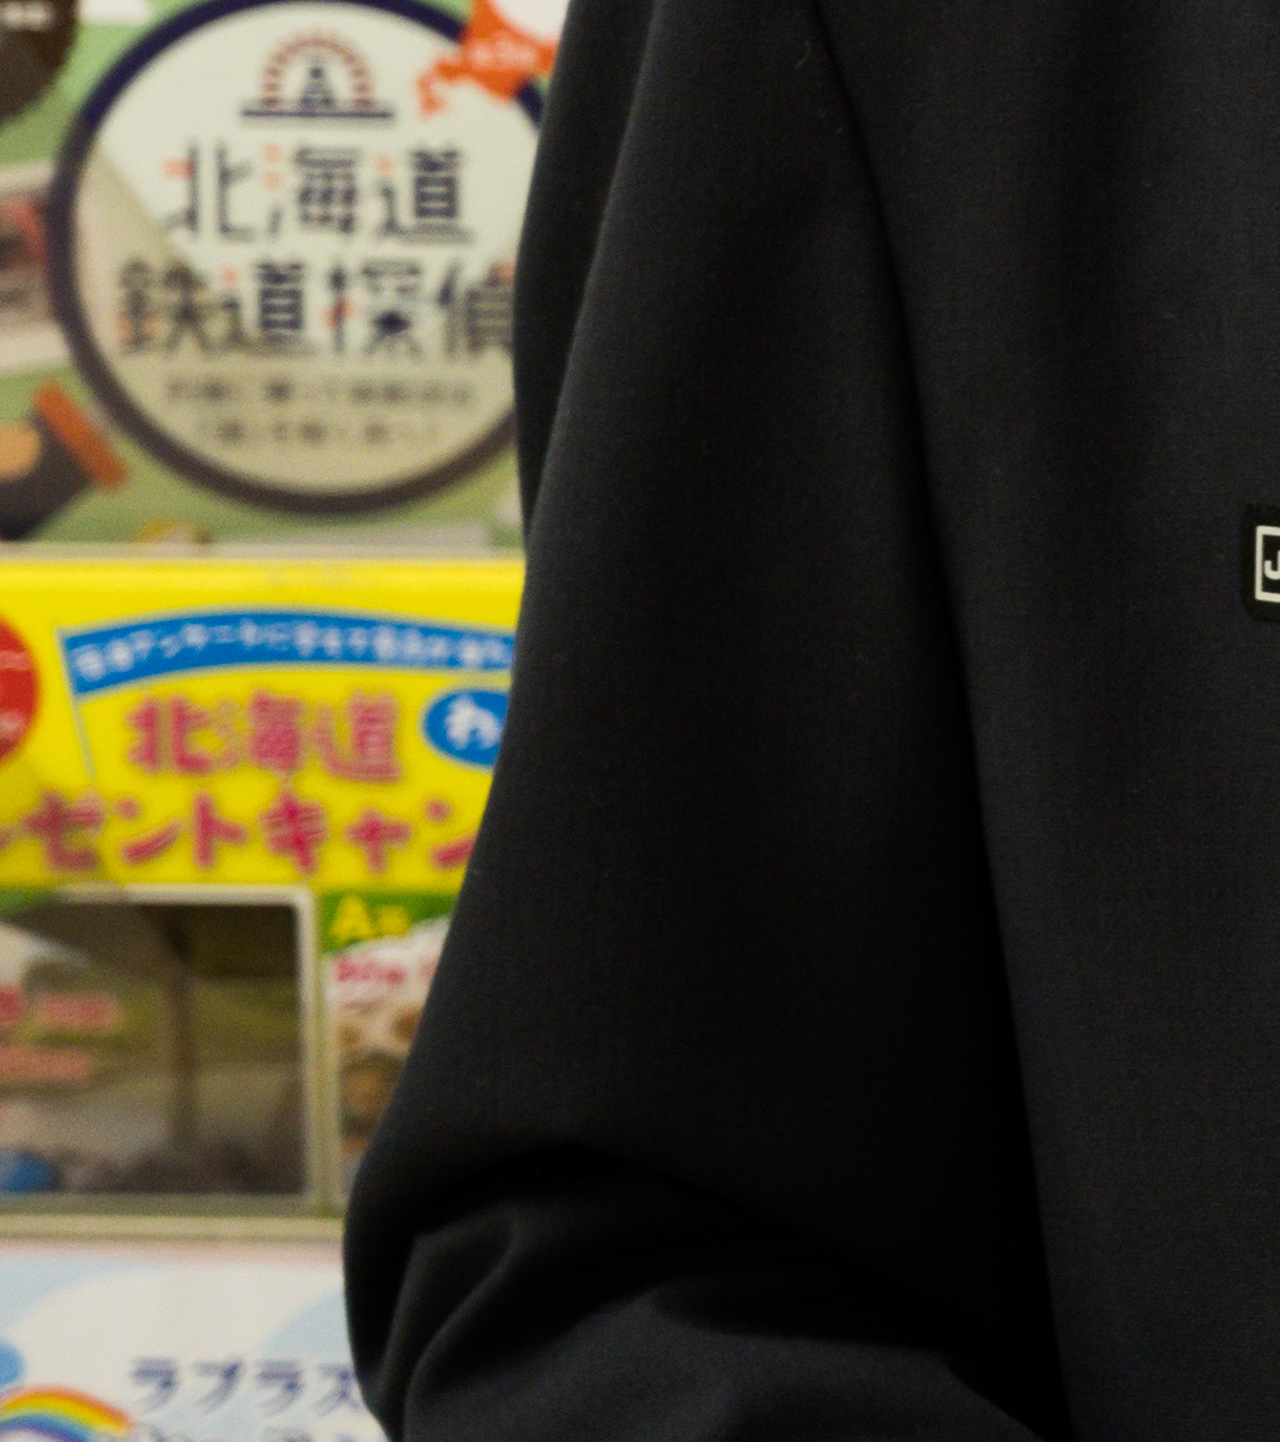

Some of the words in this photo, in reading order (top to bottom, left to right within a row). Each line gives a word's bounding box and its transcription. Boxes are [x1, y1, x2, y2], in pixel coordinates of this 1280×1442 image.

[160, 136, 474, 244] 北海道
[126, 688, 404, 784] 北海道
